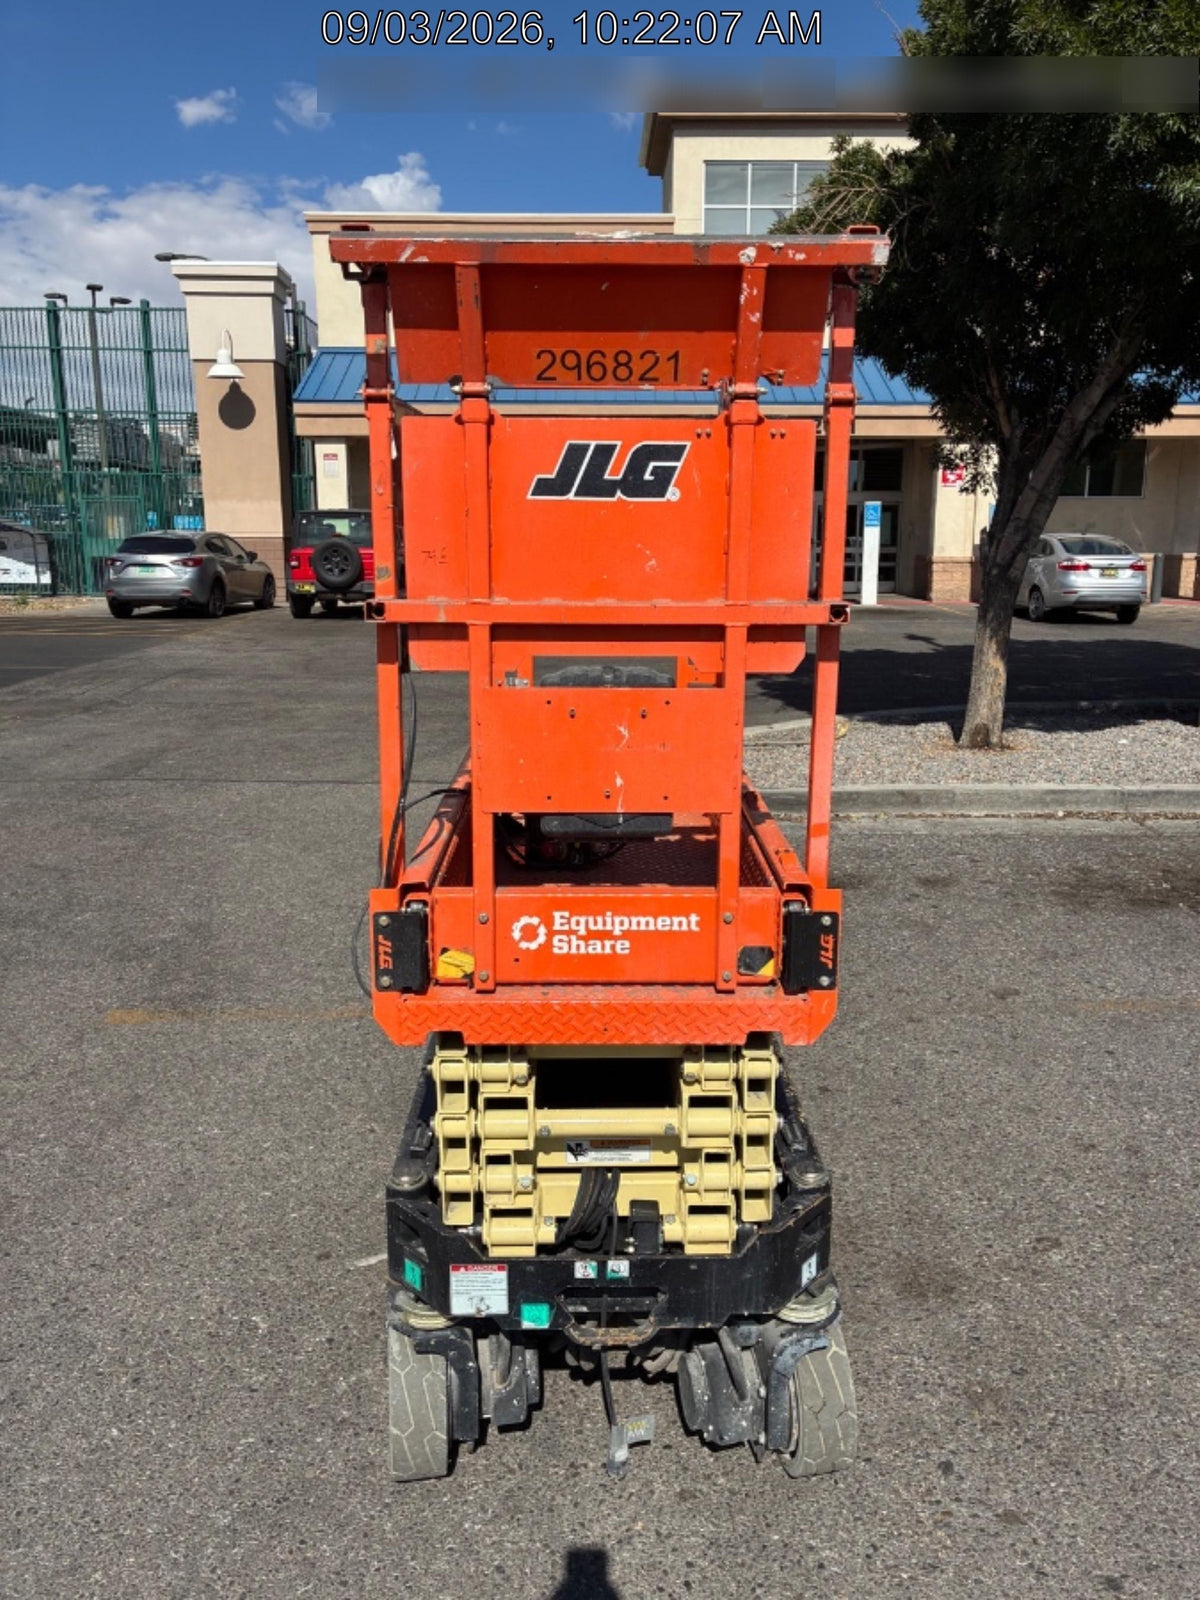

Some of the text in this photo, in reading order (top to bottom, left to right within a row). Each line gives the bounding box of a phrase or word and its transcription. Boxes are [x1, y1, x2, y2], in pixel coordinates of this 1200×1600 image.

[536, 349, 680, 383] 296821
[553, 911, 700, 935] Equipment
[552, 933, 630, 955] Share
